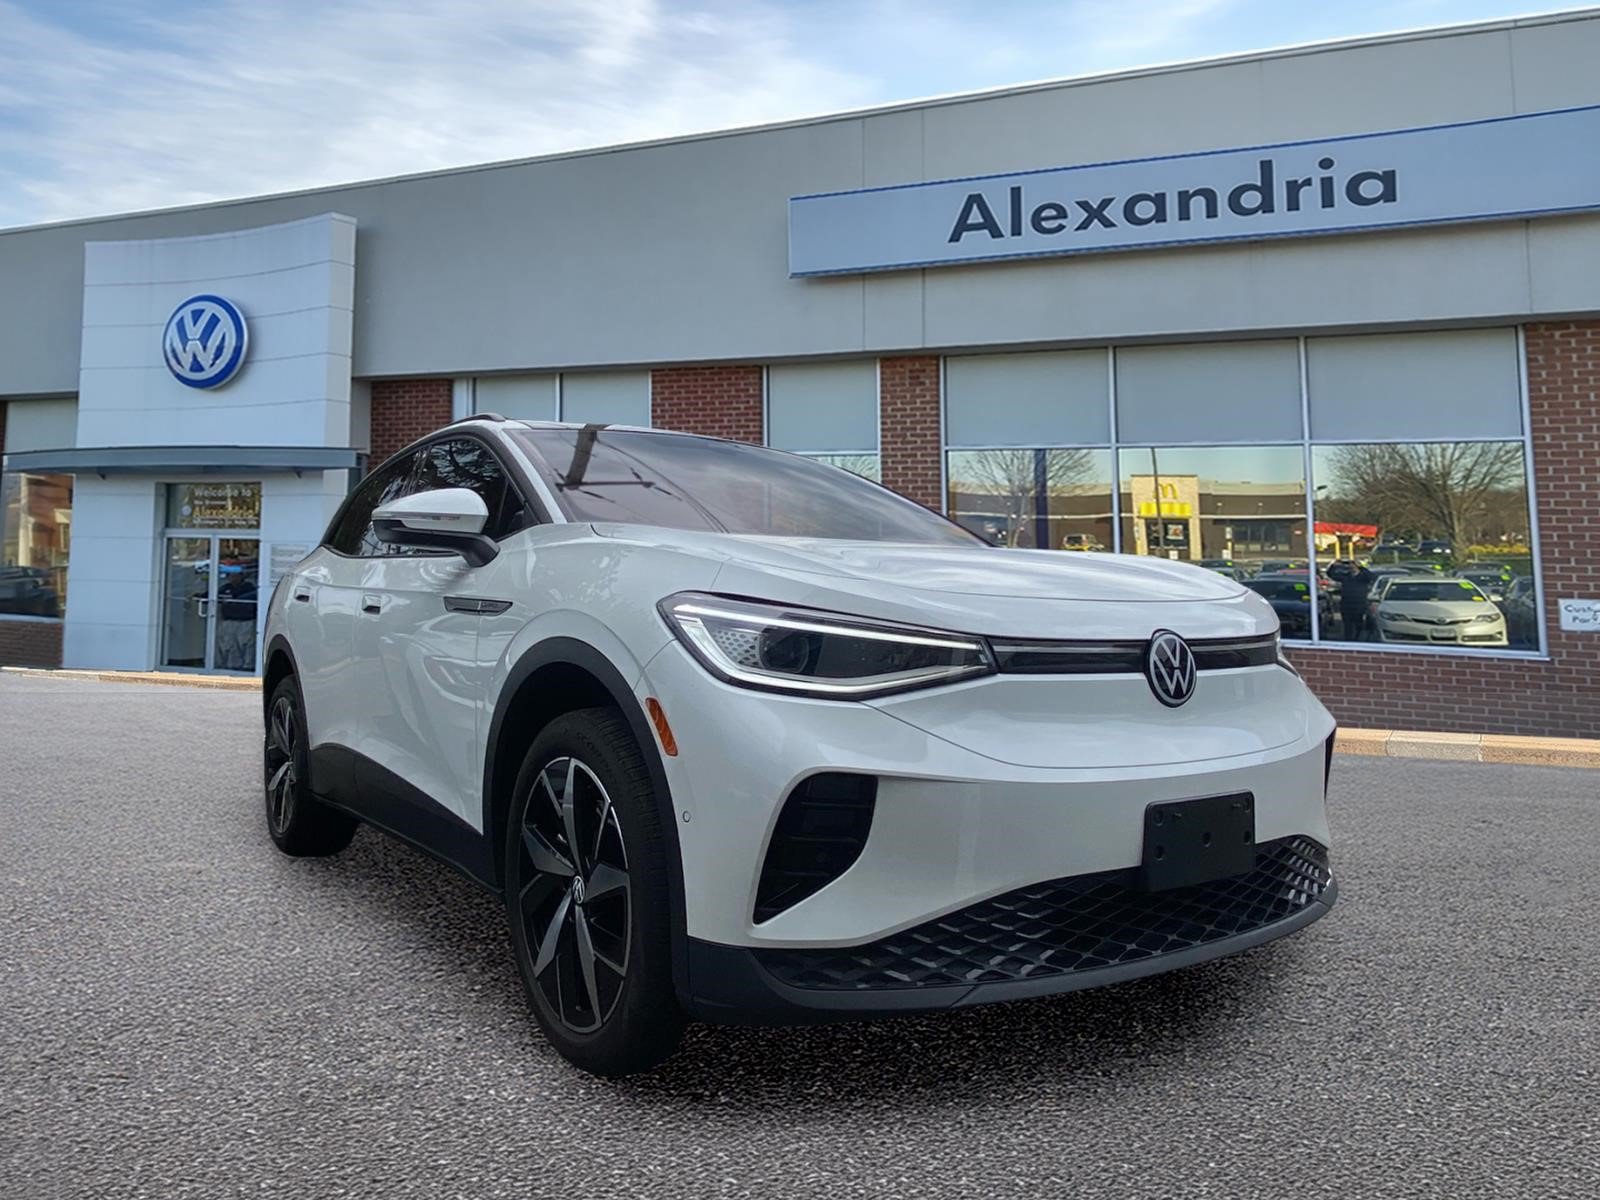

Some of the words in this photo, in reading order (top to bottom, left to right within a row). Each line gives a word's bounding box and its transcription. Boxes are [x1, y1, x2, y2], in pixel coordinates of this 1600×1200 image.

[948, 157, 1398, 244] Alexandria
[166, 299, 240, 382] VW
[193, 486, 239, 498] Welcome
[1151, 635, 1195, 702] VW
